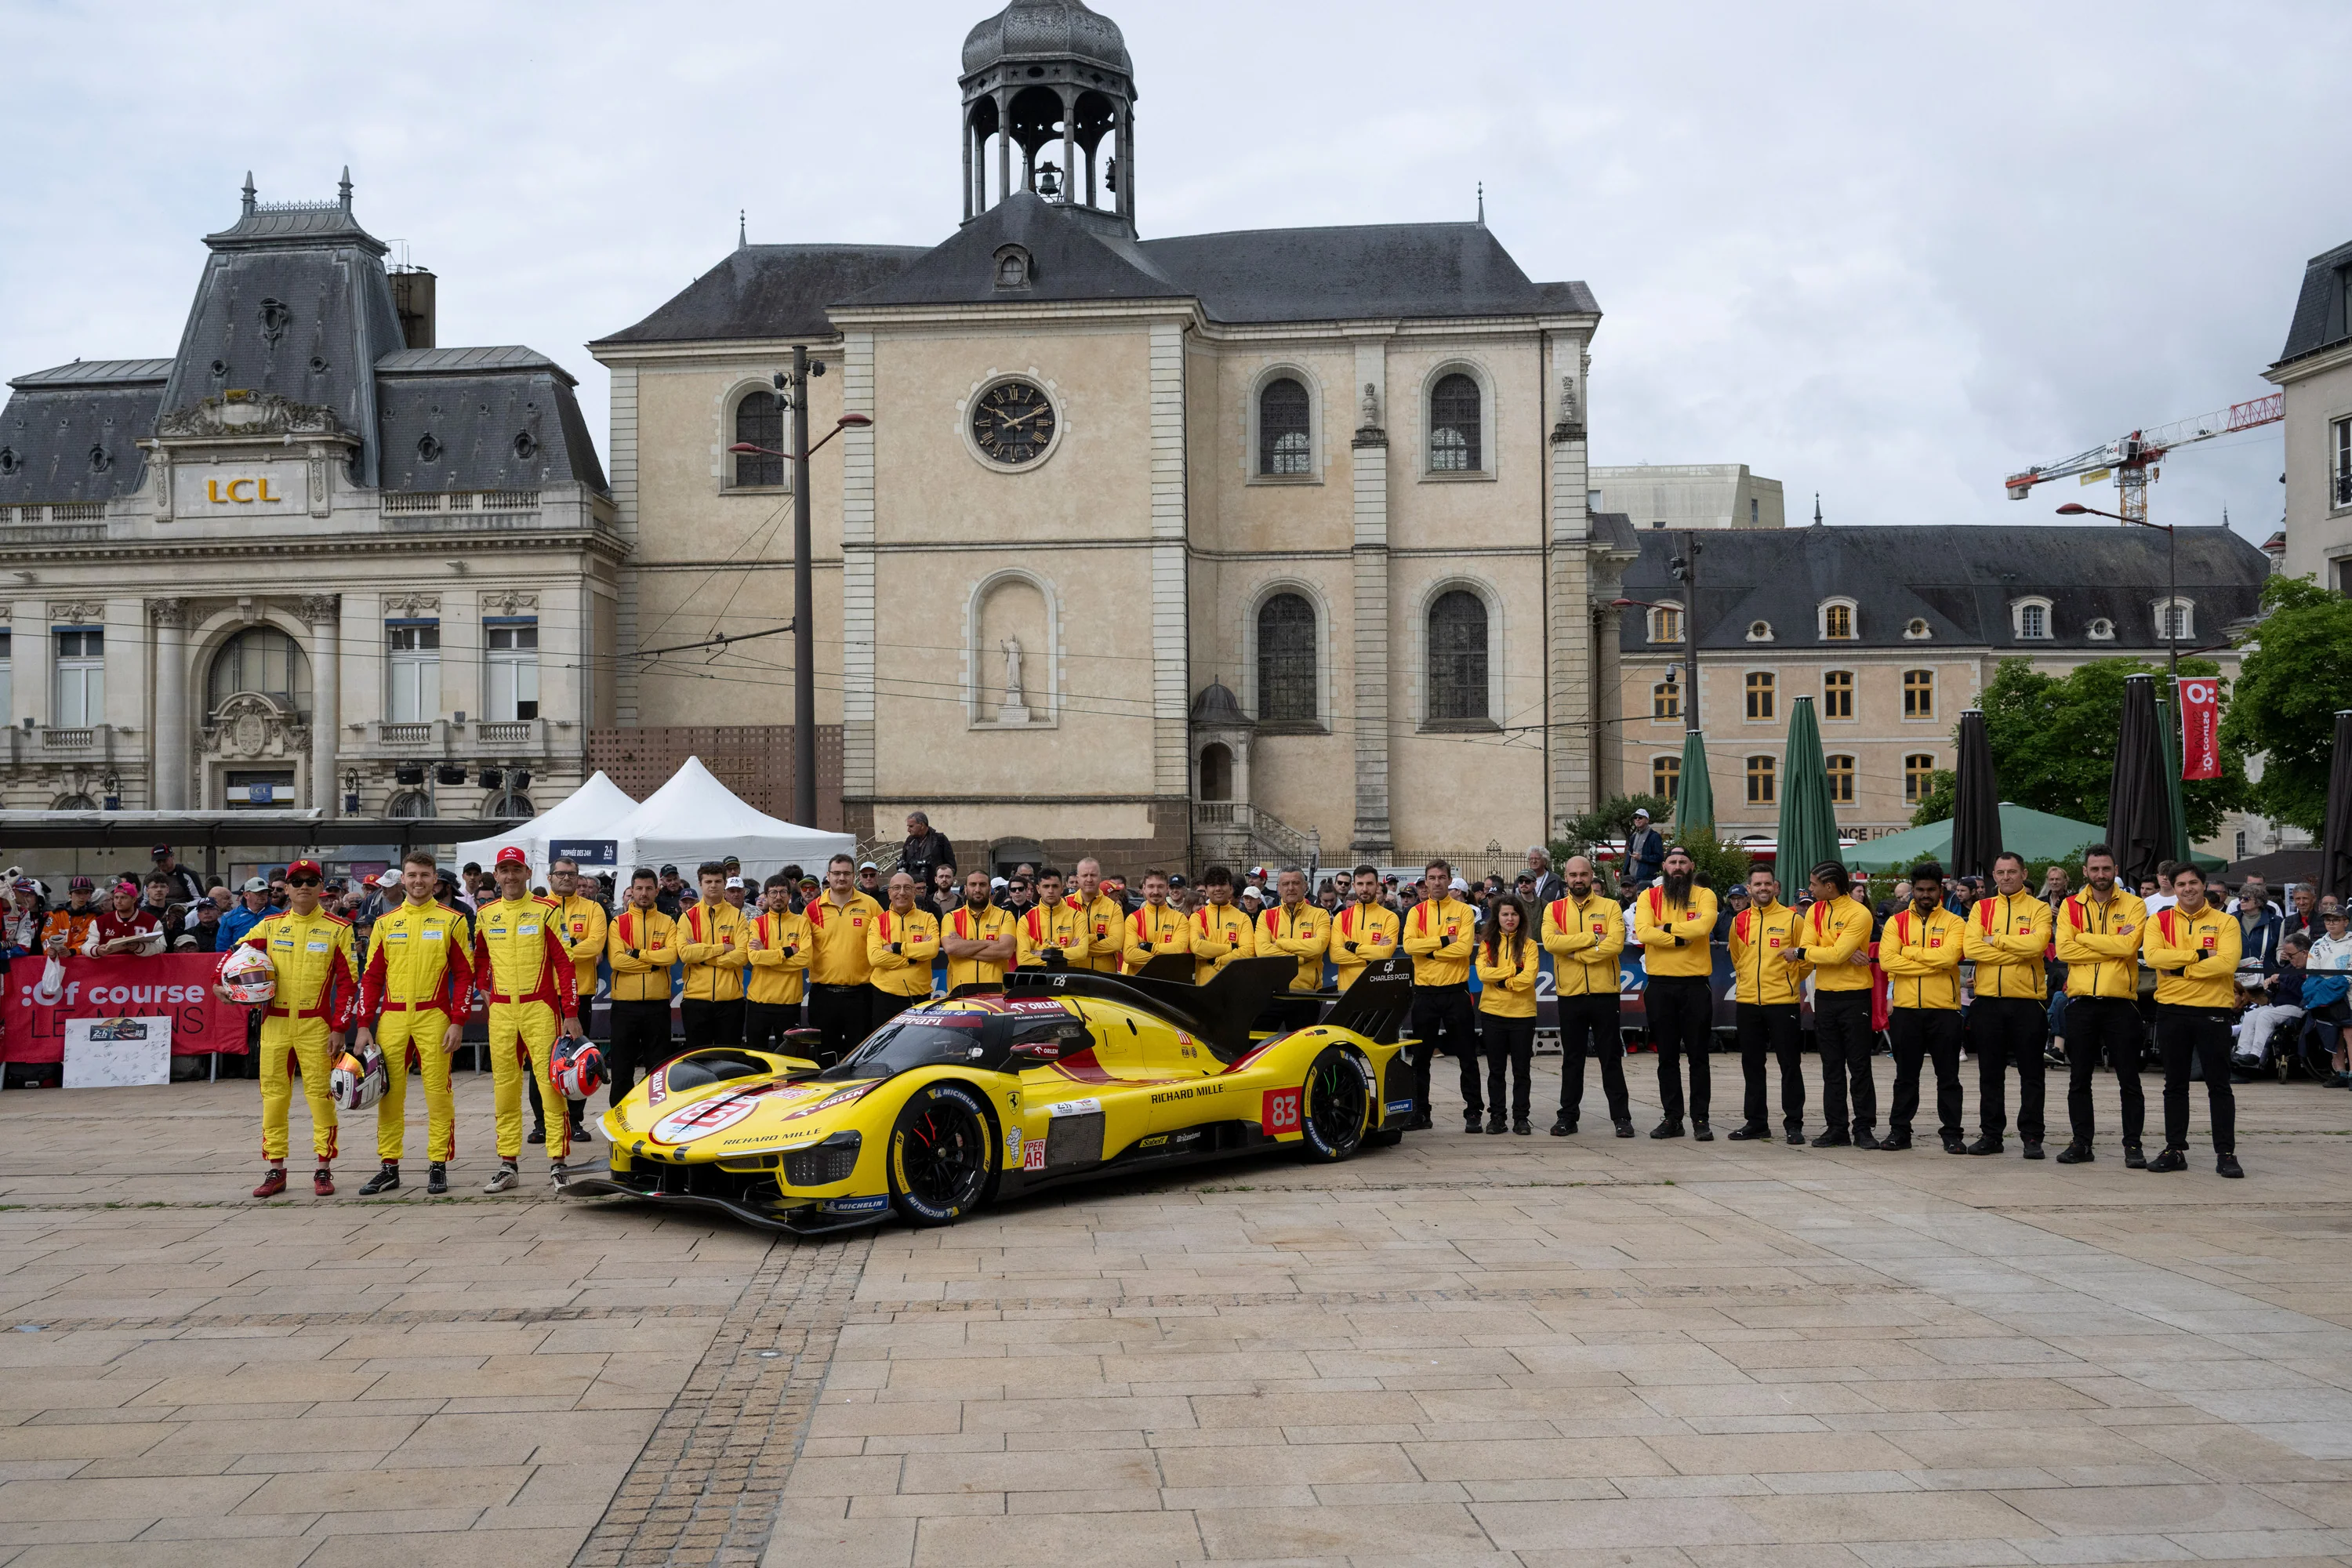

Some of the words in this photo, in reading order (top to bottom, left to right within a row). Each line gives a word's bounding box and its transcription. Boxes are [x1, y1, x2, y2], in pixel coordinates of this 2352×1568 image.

[208, 478, 281, 503] LCL
[89, 985, 205, 1004] course
[1028, 1001, 1062, 1010] ORLEN
[31, 1008, 76, 1039] LE
[652, 1071, 664, 1093] ORLEN
[1348, 1056, 1368, 1086] MICHELIN
[818, 1088, 865, 1108] ORLEN
[942, 1088, 978, 1110] MICHELIN
[1151, 1089, 1194, 1105] RICHARD
[1196, 1083, 1224, 1097] MILLE
[1272, 1095, 1298, 1127] 83
[723, 1134, 779, 1145] RICHARD
[782, 1127, 822, 1139] MILLE
[1142, 1138, 1165, 1146] Sabelt
[1307, 1121, 1328, 1152] MICHELIN
[838, 1200, 884, 1210] MICHELIN
[908, 1196, 946, 1218] MICHELIN
